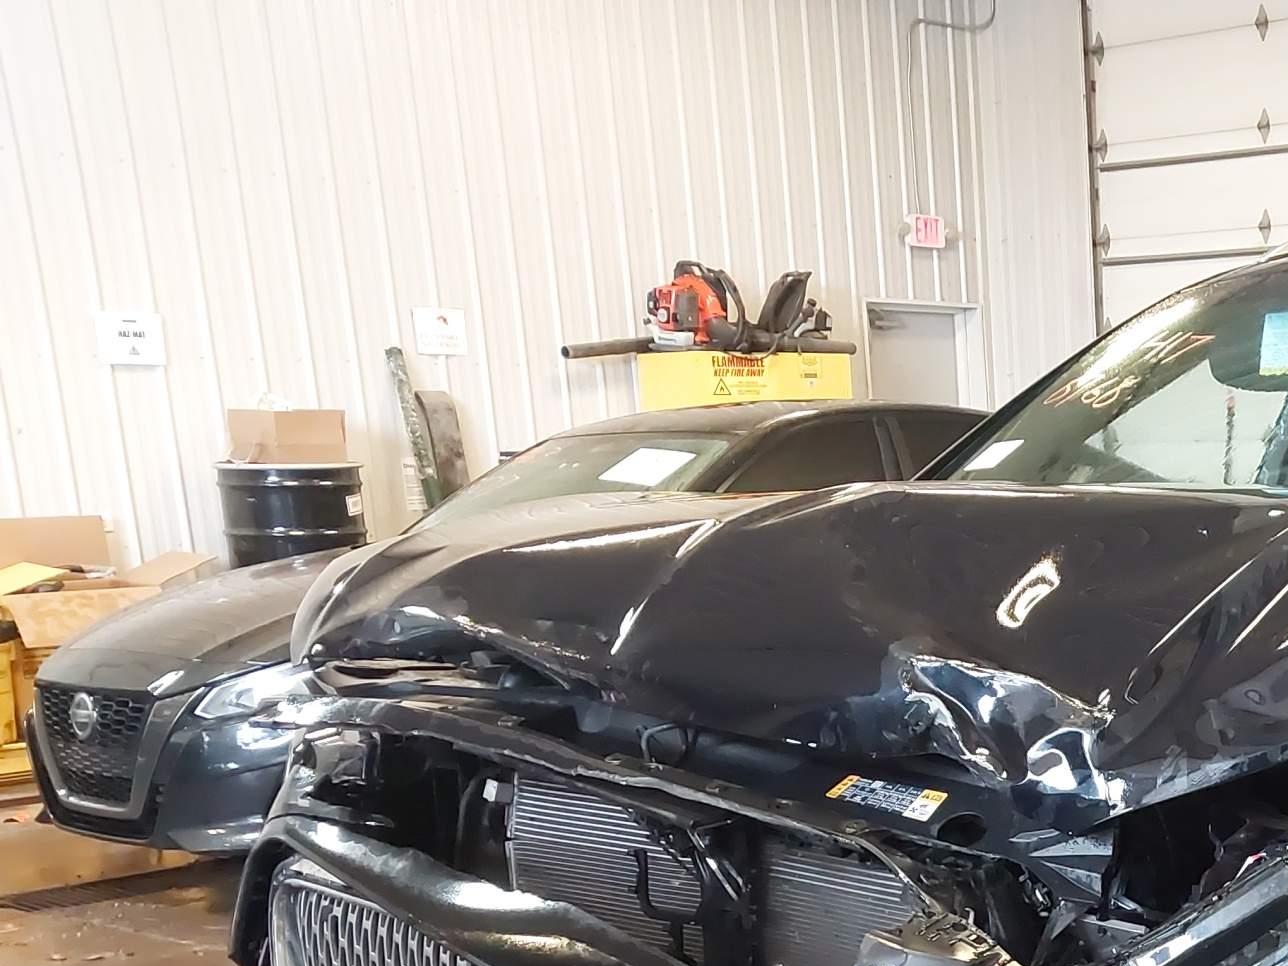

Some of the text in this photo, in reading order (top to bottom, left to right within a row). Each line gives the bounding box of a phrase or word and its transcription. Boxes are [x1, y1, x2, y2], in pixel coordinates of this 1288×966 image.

[916, 216, 940, 244] EXIT
[711, 355, 765, 368] FLAMMABLE
[714, 368, 765, 377] KEEP FIRE AWAY
